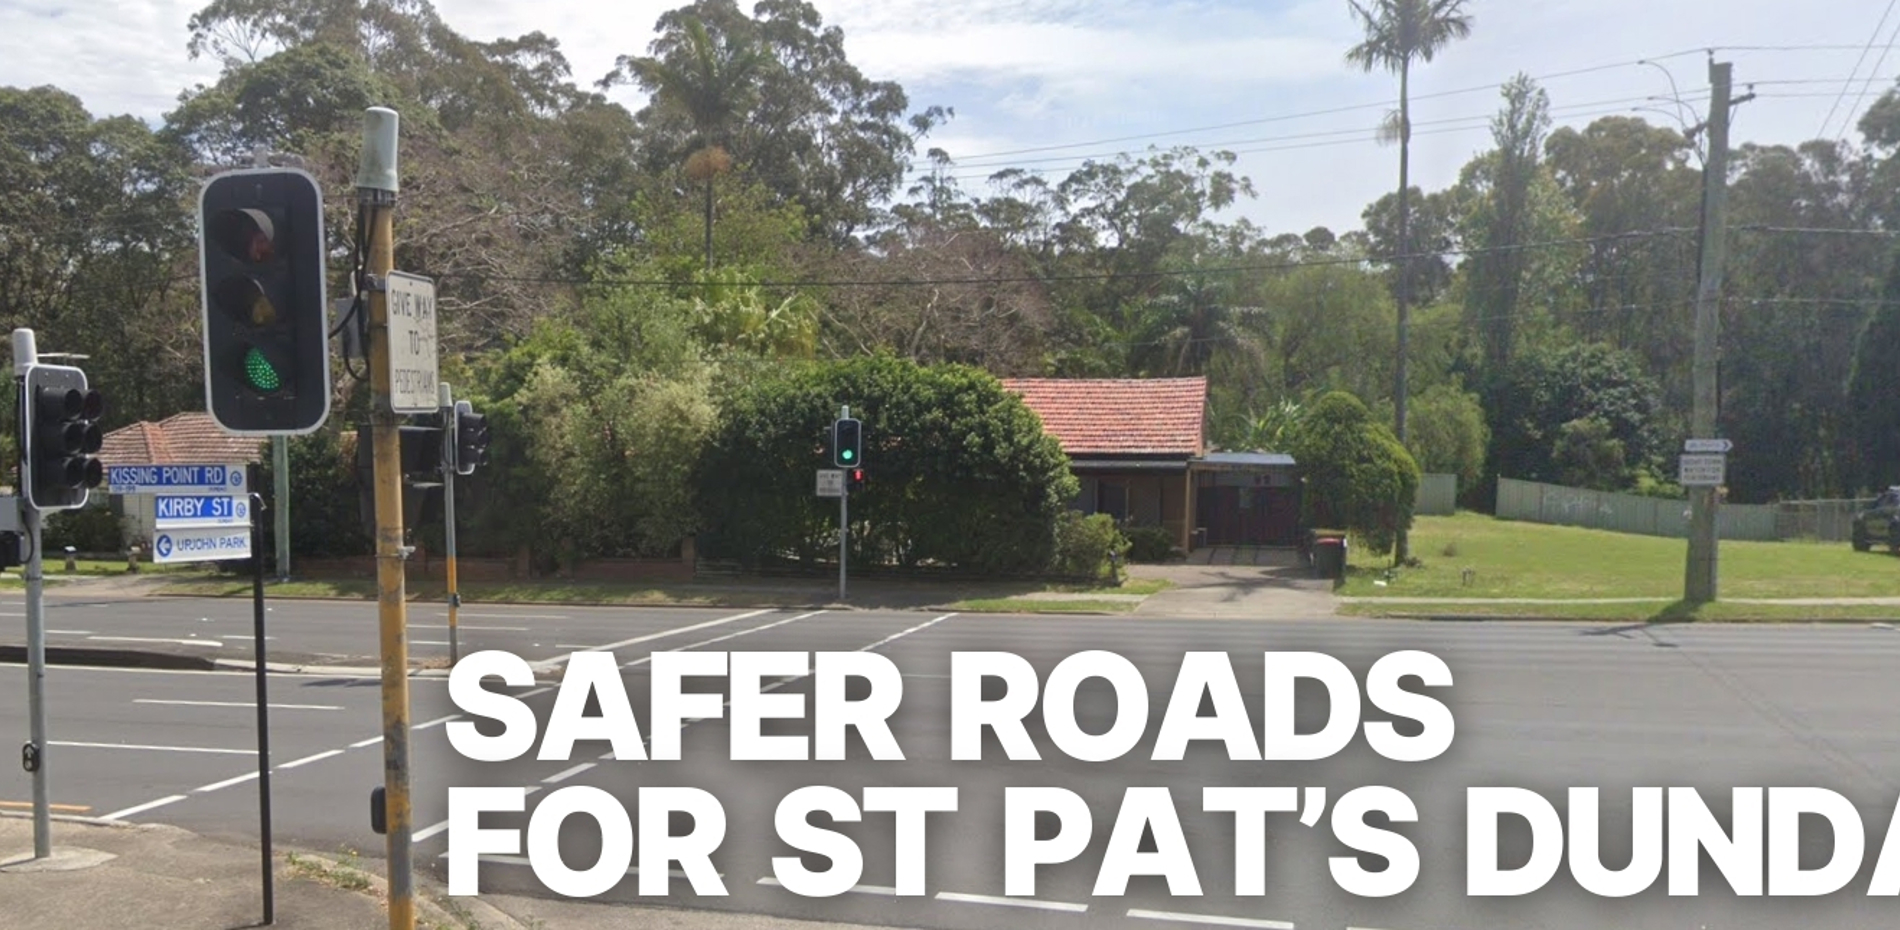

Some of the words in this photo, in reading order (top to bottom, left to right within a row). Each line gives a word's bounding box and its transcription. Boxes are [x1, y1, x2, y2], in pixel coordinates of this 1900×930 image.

[392, 288, 412, 317] GIVE
[414, 293, 433, 320] WAY
[408, 330, 420, 356] TO
[395, 368, 435, 394] PEDESTRIANS
[110, 466, 158, 484] KISSING
[162, 466, 200, 484] POINT
[205, 466, 223, 484] RD
[158, 497, 204, 517] KIRBY
[211, 497, 231, 516] ST
[176, 537, 217, 552] UPJOHN
[220, 536, 246, 549] PARK
